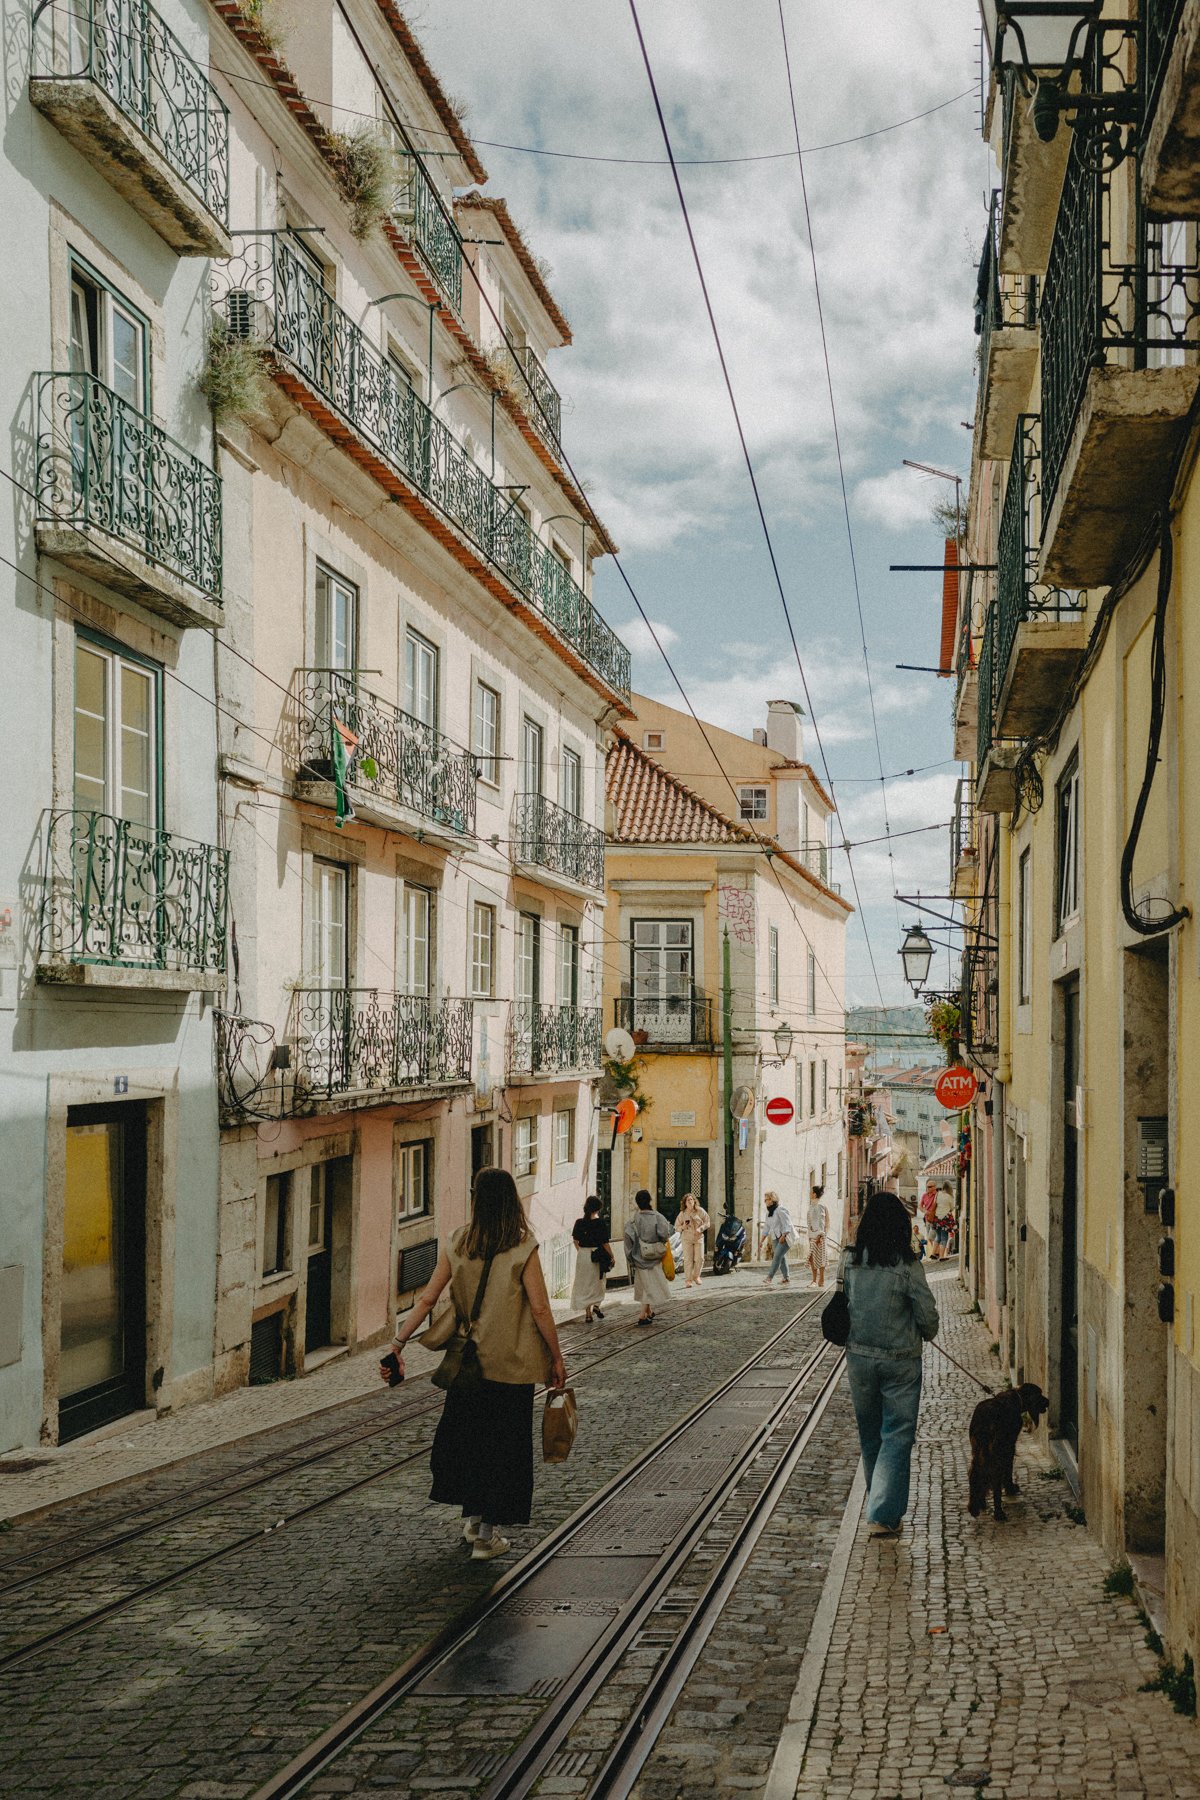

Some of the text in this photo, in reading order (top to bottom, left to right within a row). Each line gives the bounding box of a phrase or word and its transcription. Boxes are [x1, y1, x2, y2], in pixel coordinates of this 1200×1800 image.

[119, 1076, 125, 1093] 6
[941, 1076, 973, 1089] ATM
[941, 1089, 972, 1097] Express
